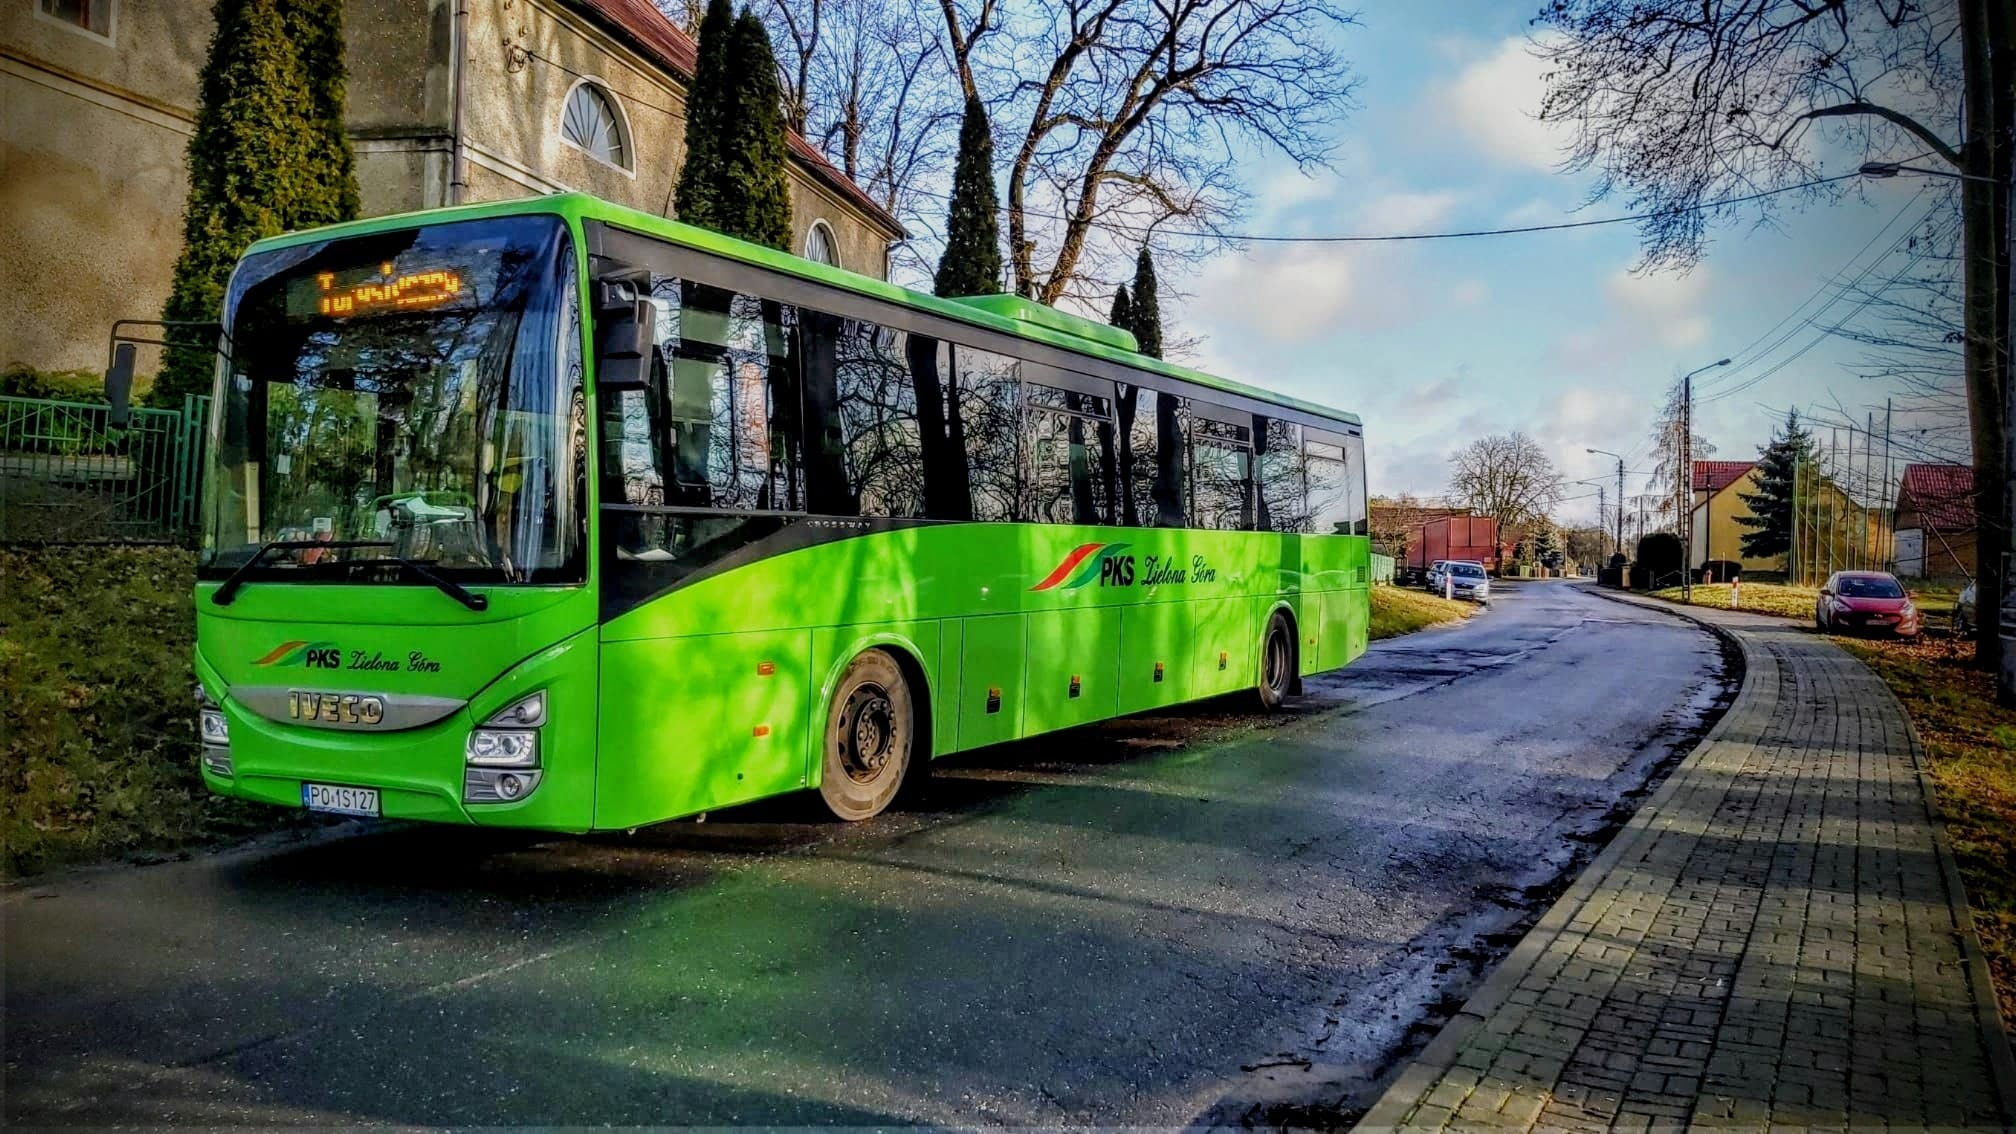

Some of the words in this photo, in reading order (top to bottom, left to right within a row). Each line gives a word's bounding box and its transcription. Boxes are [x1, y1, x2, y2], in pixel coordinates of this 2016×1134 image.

[1100, 555, 1135, 587] PKS
[1141, 555, 1186, 585] Zielona
[1191, 554, 1216, 583] Góra
[306, 649, 341, 668] PKS
[347, 650, 400, 671] Zielona
[407, 651, 441, 672] Góra
[288, 692, 384, 725] IVECO
